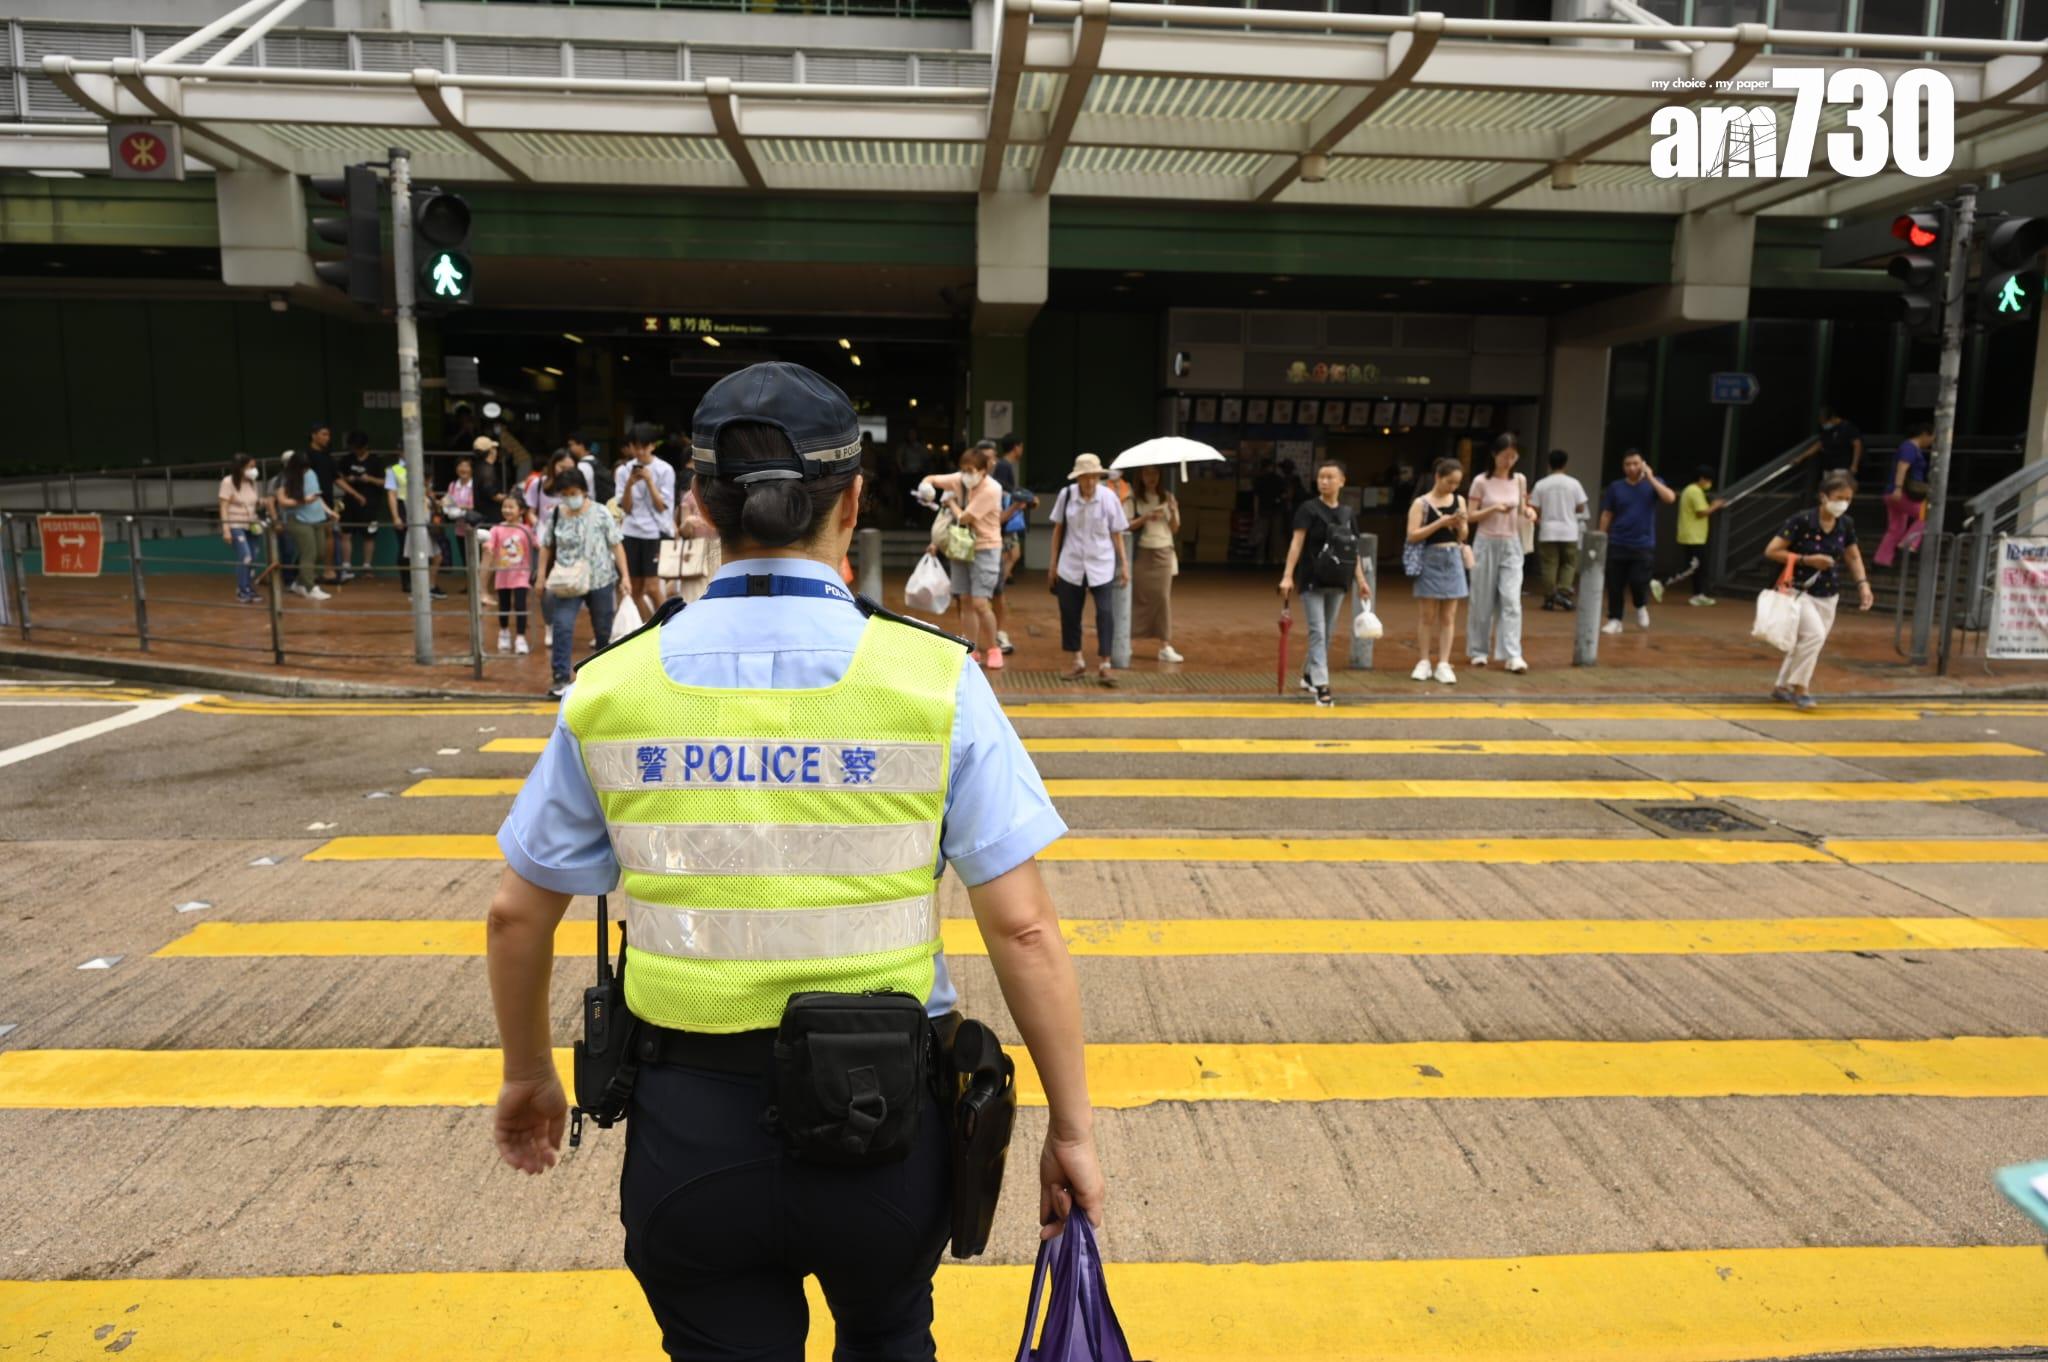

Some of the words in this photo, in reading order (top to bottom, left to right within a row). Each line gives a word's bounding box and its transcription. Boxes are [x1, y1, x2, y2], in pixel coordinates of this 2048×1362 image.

[61, 553, 83, 569] 行人
[637, 745, 667, 783] 警
[684, 744, 820, 783] POLICE
[840, 747, 876, 784] 察
